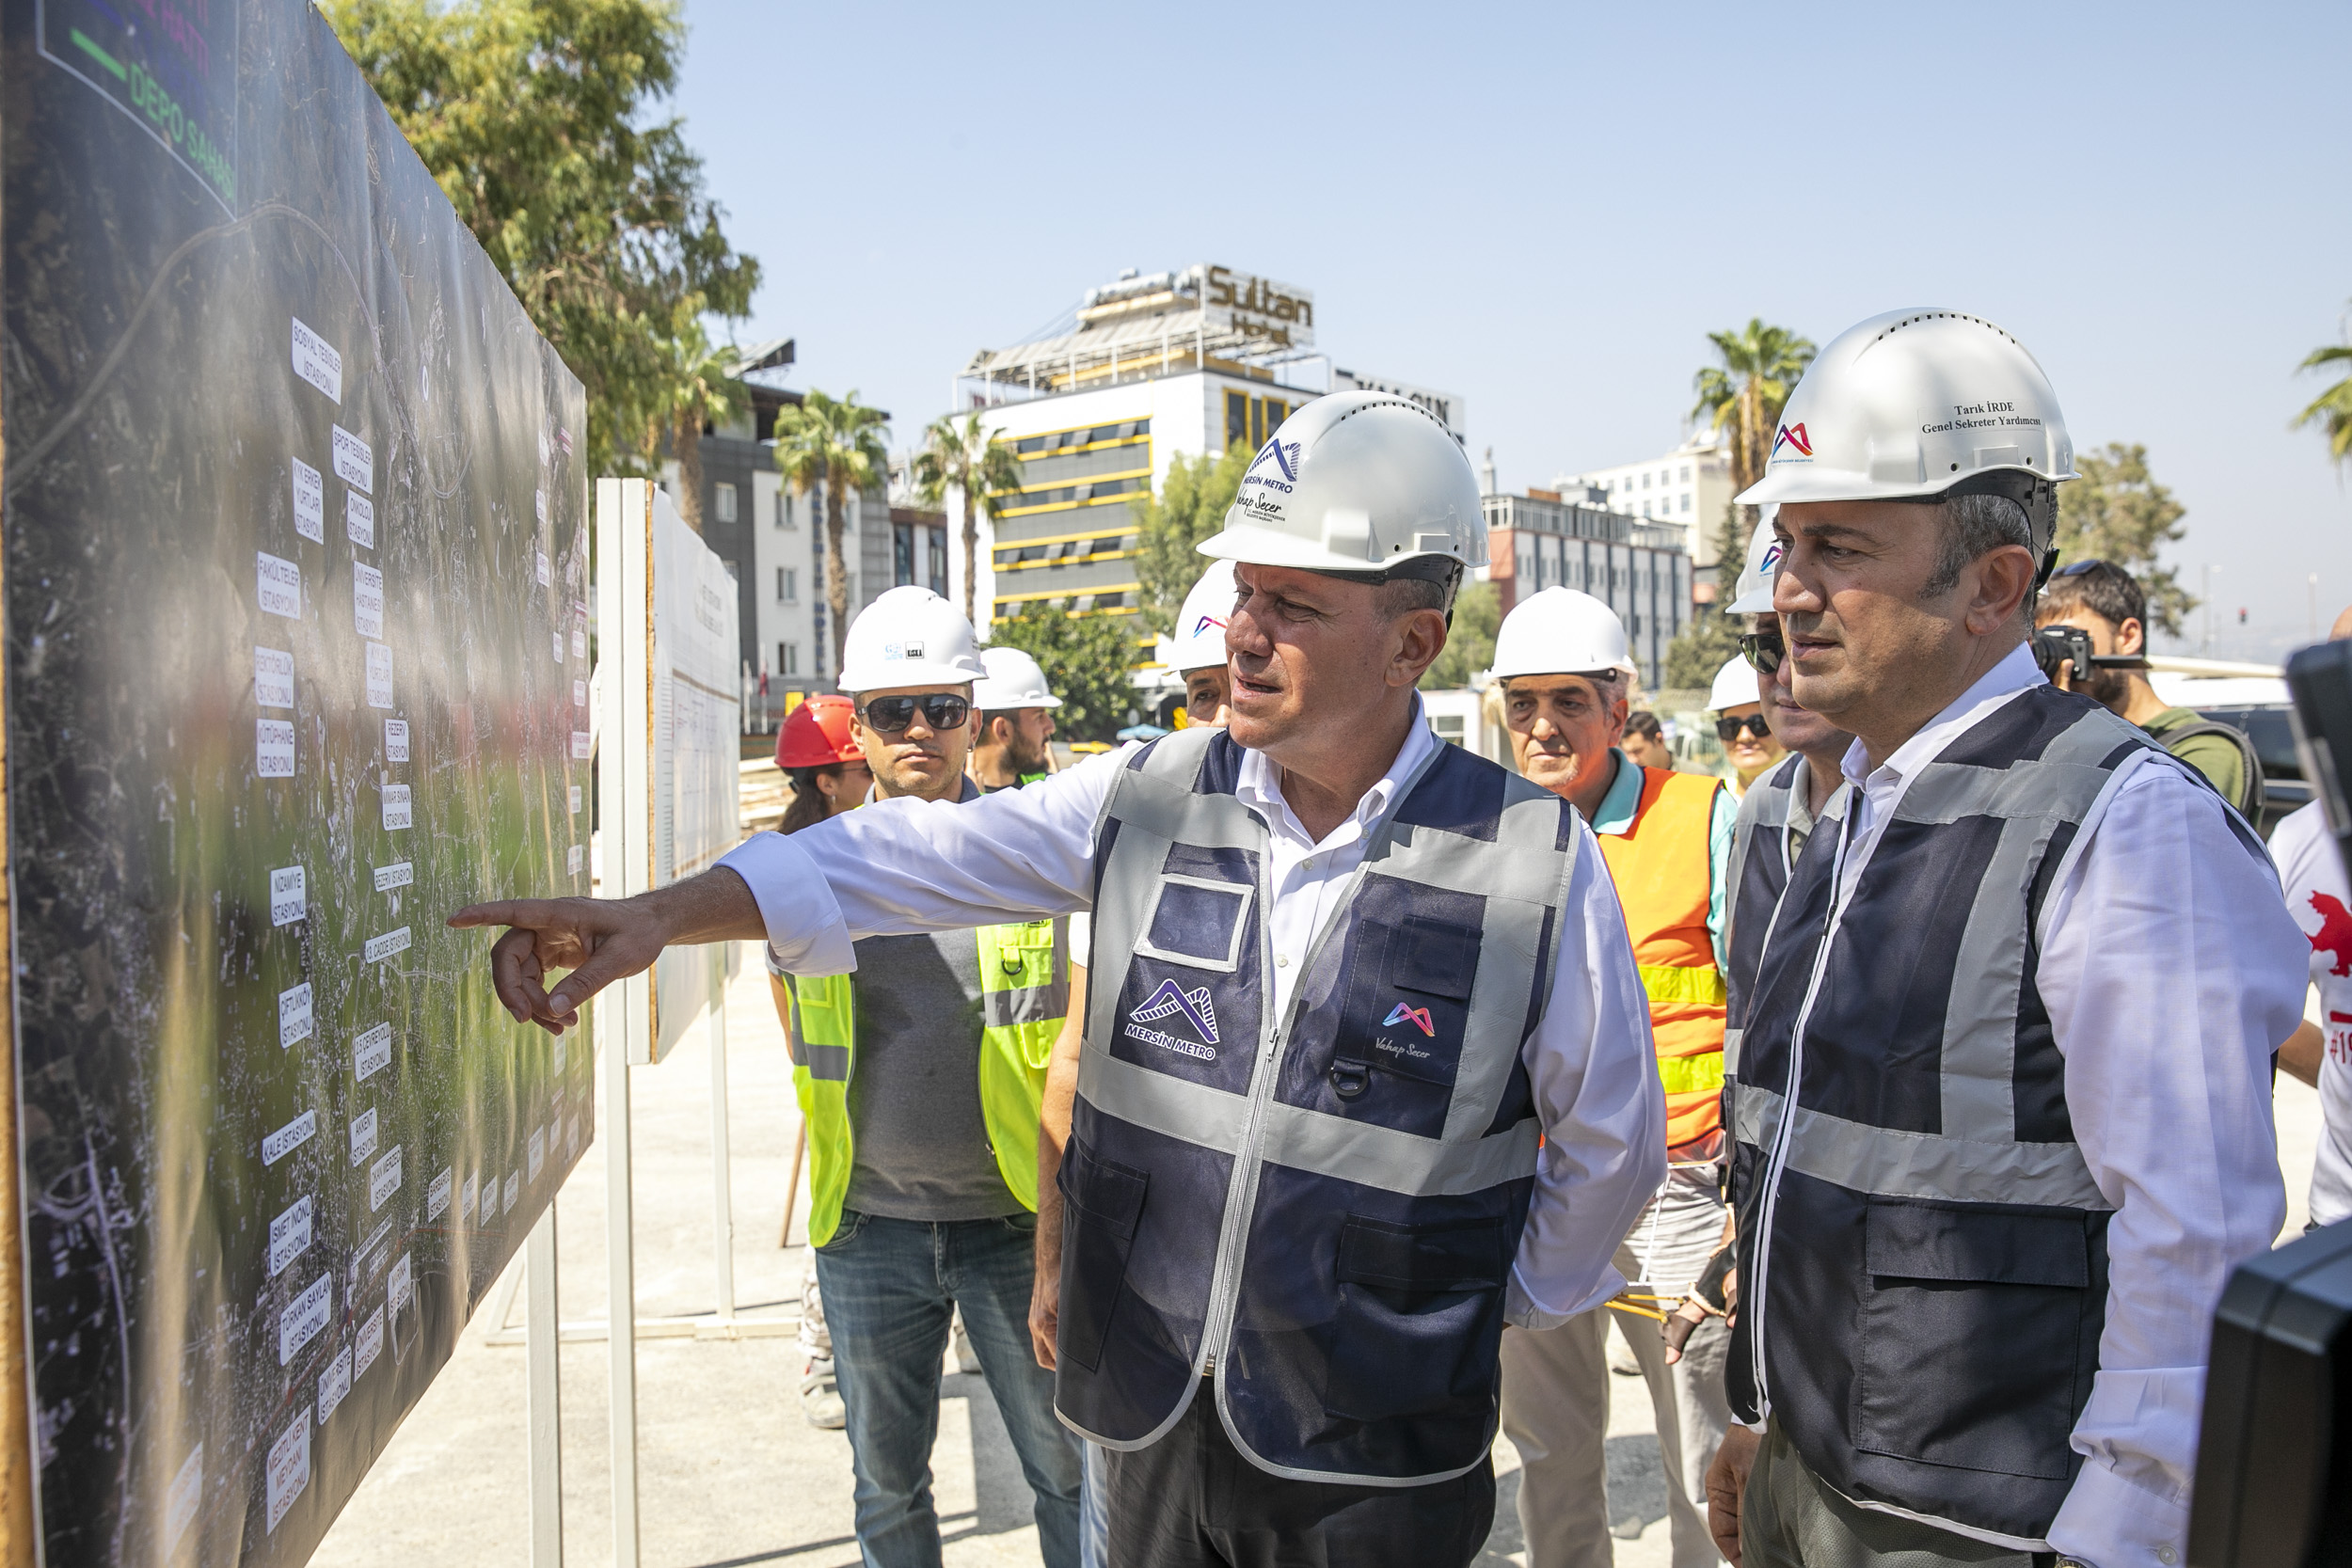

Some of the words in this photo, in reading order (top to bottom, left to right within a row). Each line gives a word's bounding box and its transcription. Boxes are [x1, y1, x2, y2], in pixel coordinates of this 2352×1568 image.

[130, 61, 183, 143] DEPO
[1209, 264, 1312, 327] Sultan
[294, 325, 318, 356] SOSYAL
[1231, 312, 1292, 347] Hotel
[1954, 404, 1985, 416] Tarık
[1987, 401, 2015, 413] İRDE
[1921, 420, 1953, 434] Genel
[1955, 418, 1996, 430] Sekreter
[1998, 416, 2042, 426] Yardımcısı
[334, 431, 350, 452] SPOR
[1263, 478, 1293, 494] METRO
[259, 559, 299, 588] FAKÜLTELER
[388, 721, 406, 736] REZERV
[373, 940, 389, 958] CADDE
[1124, 1022, 1175, 1050] MERSİN
[1172, 1038, 1216, 1061] METRO
[1375, 1037, 1406, 1059] Vahap
[262, 1138, 282, 1161] KALE
[271, 1220, 290, 1246] İSMET
[281, 1302, 307, 1333] TÜRKAN
[307, 1277, 331, 1311] SAYLAN
[292, 1413, 310, 1445] KENT
